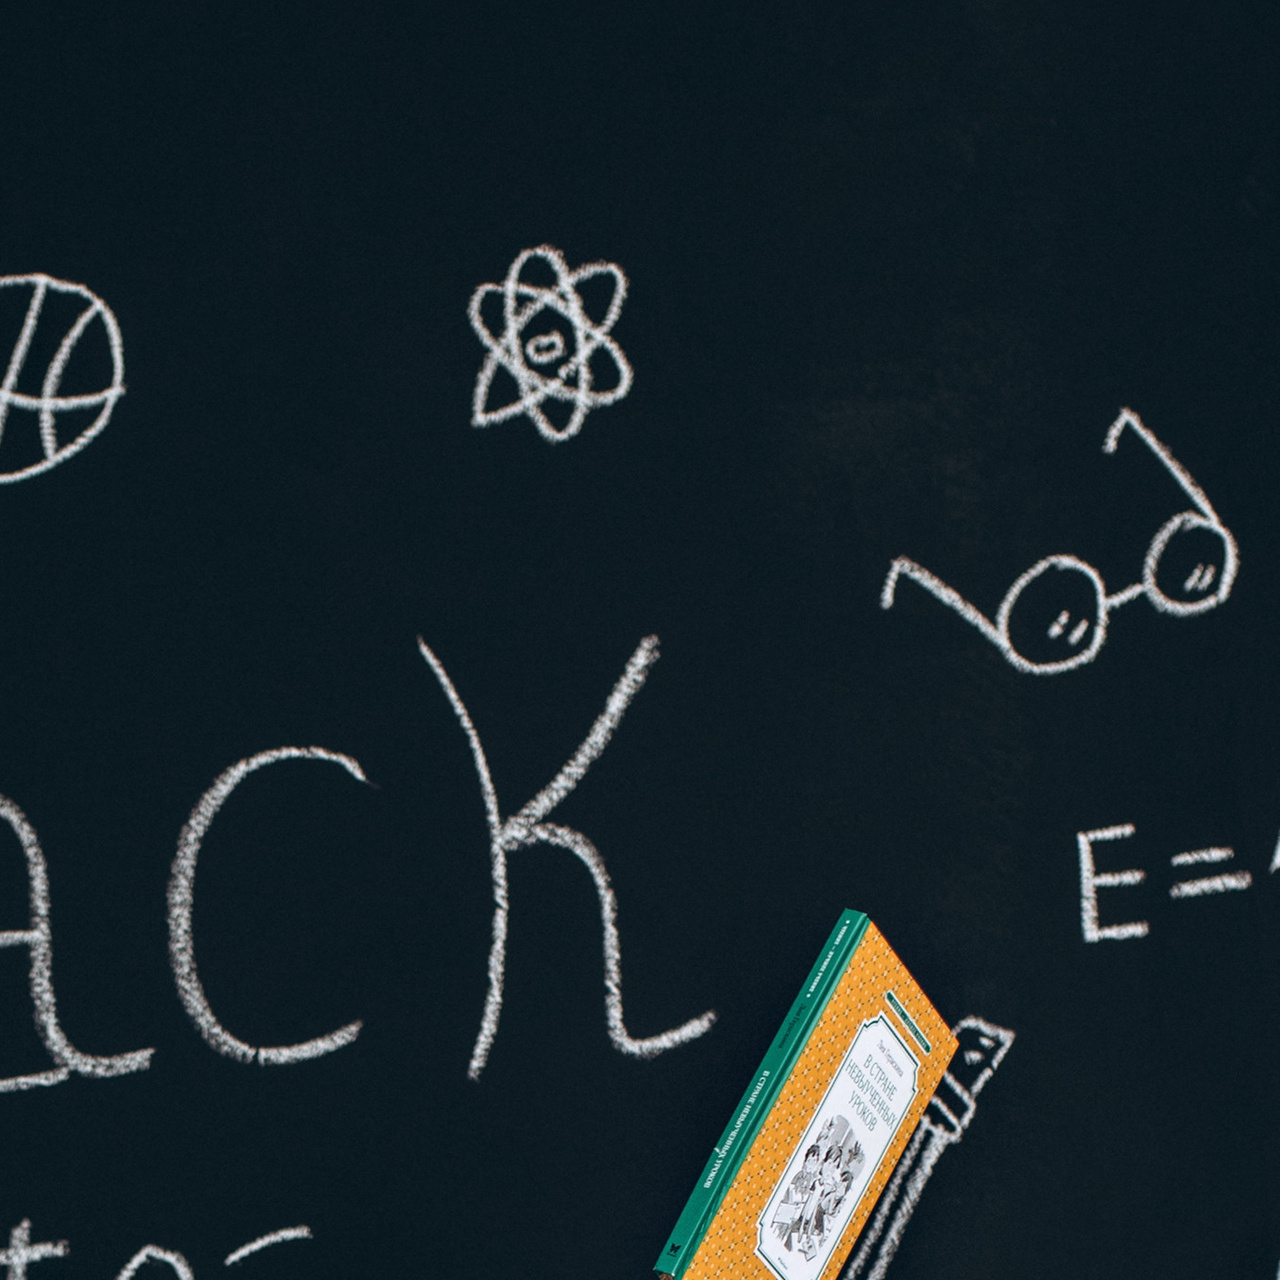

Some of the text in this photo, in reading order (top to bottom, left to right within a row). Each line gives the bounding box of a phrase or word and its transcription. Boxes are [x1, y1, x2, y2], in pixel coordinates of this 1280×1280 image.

[1077, 824, 1280, 943] E=
[845, 1058, 898, 1131] НЕВЫУЧЕННЫХ
[863, 1053, 898, 1102] В СТРАНЕ
[848, 1090, 878, 1132] УРОКОВ
